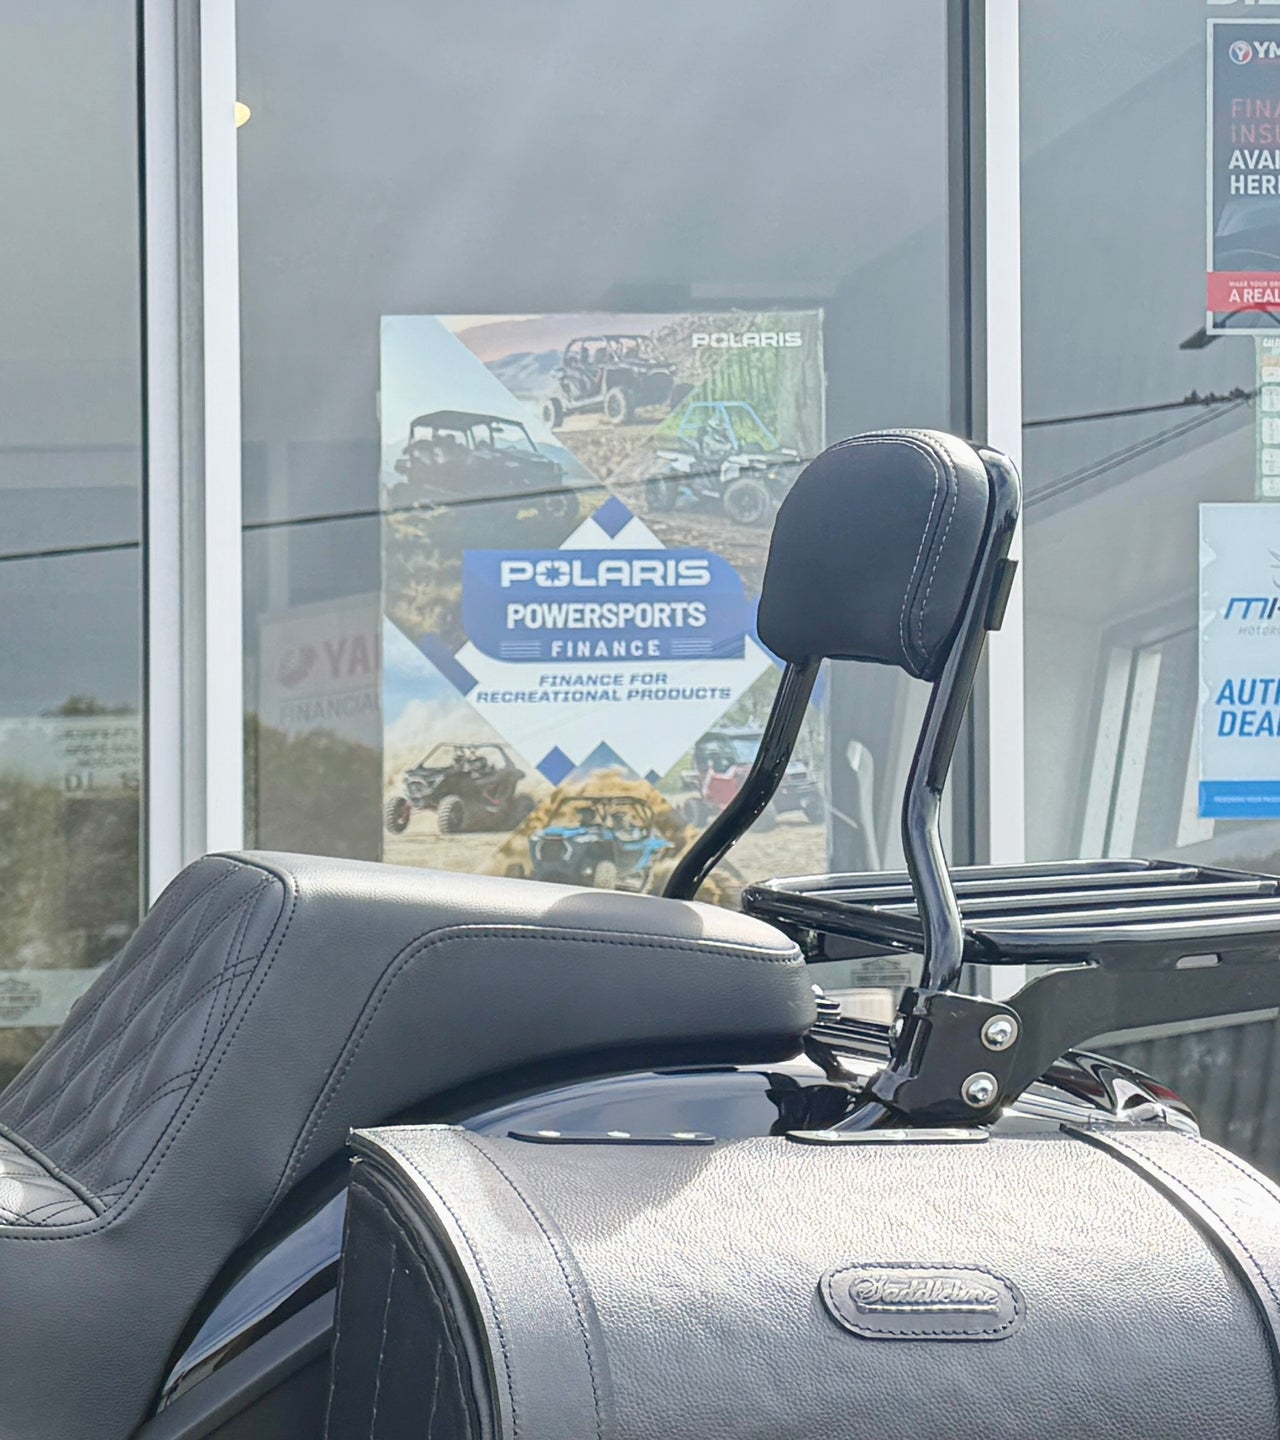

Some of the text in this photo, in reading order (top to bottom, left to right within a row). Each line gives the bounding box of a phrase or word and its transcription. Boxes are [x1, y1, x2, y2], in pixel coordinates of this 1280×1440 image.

[1230, 174, 1280, 195] HER
[1228, 288, 1240, 303] A
[691, 331, 803, 349] POLARIS
[500, 558, 712, 588] POLARIS
[506, 601, 707, 629] POWERSPORTS
[551, 639, 661, 658] FINANCE
[538, 672, 669, 688] FINANCE FOR
[476, 686, 732, 704] RECREATIONAL PRODUCTS
